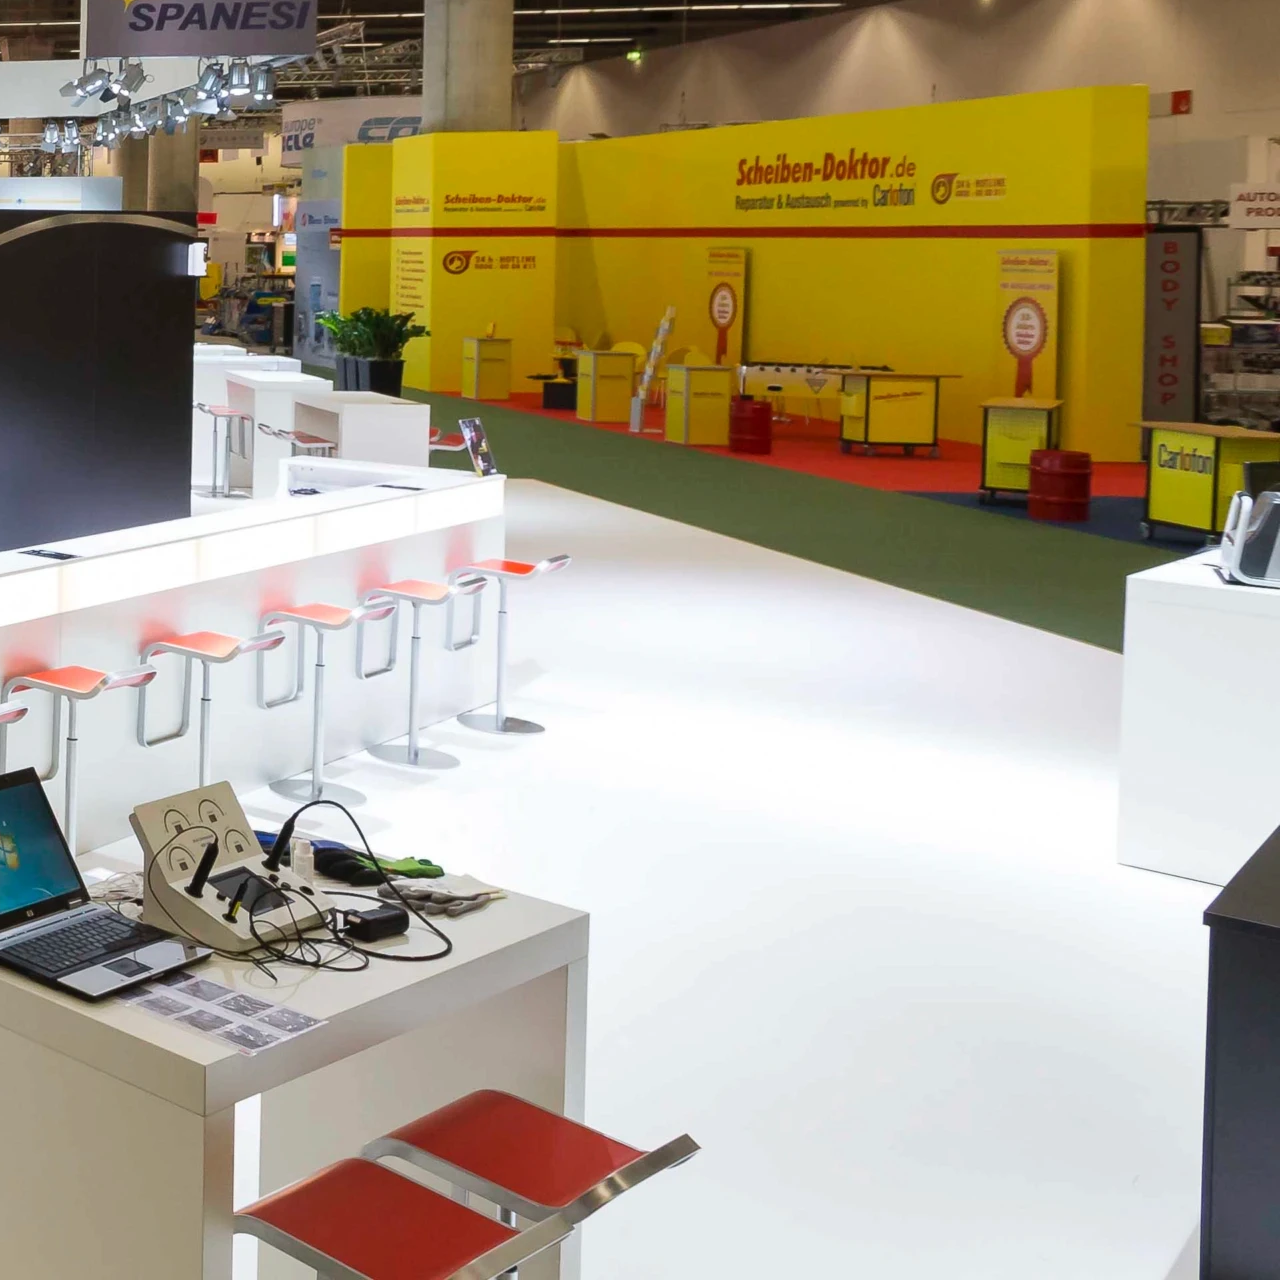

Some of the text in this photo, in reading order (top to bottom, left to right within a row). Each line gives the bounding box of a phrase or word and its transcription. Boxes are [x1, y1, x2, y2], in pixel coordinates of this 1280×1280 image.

[128, 0, 311, 32] SPANESI
[735, 148, 917, 186] Scheiben-Doktor.de
[735, 193, 774, 212] Reparatur
[785, 192, 832, 209] Austausch
[1237, 191, 1280, 203] AUTO
[1160, 241, 1180, 311] BODY
[1158, 335, 1180, 405] SHOP
[1158, 442, 1213, 476] Carlofon
